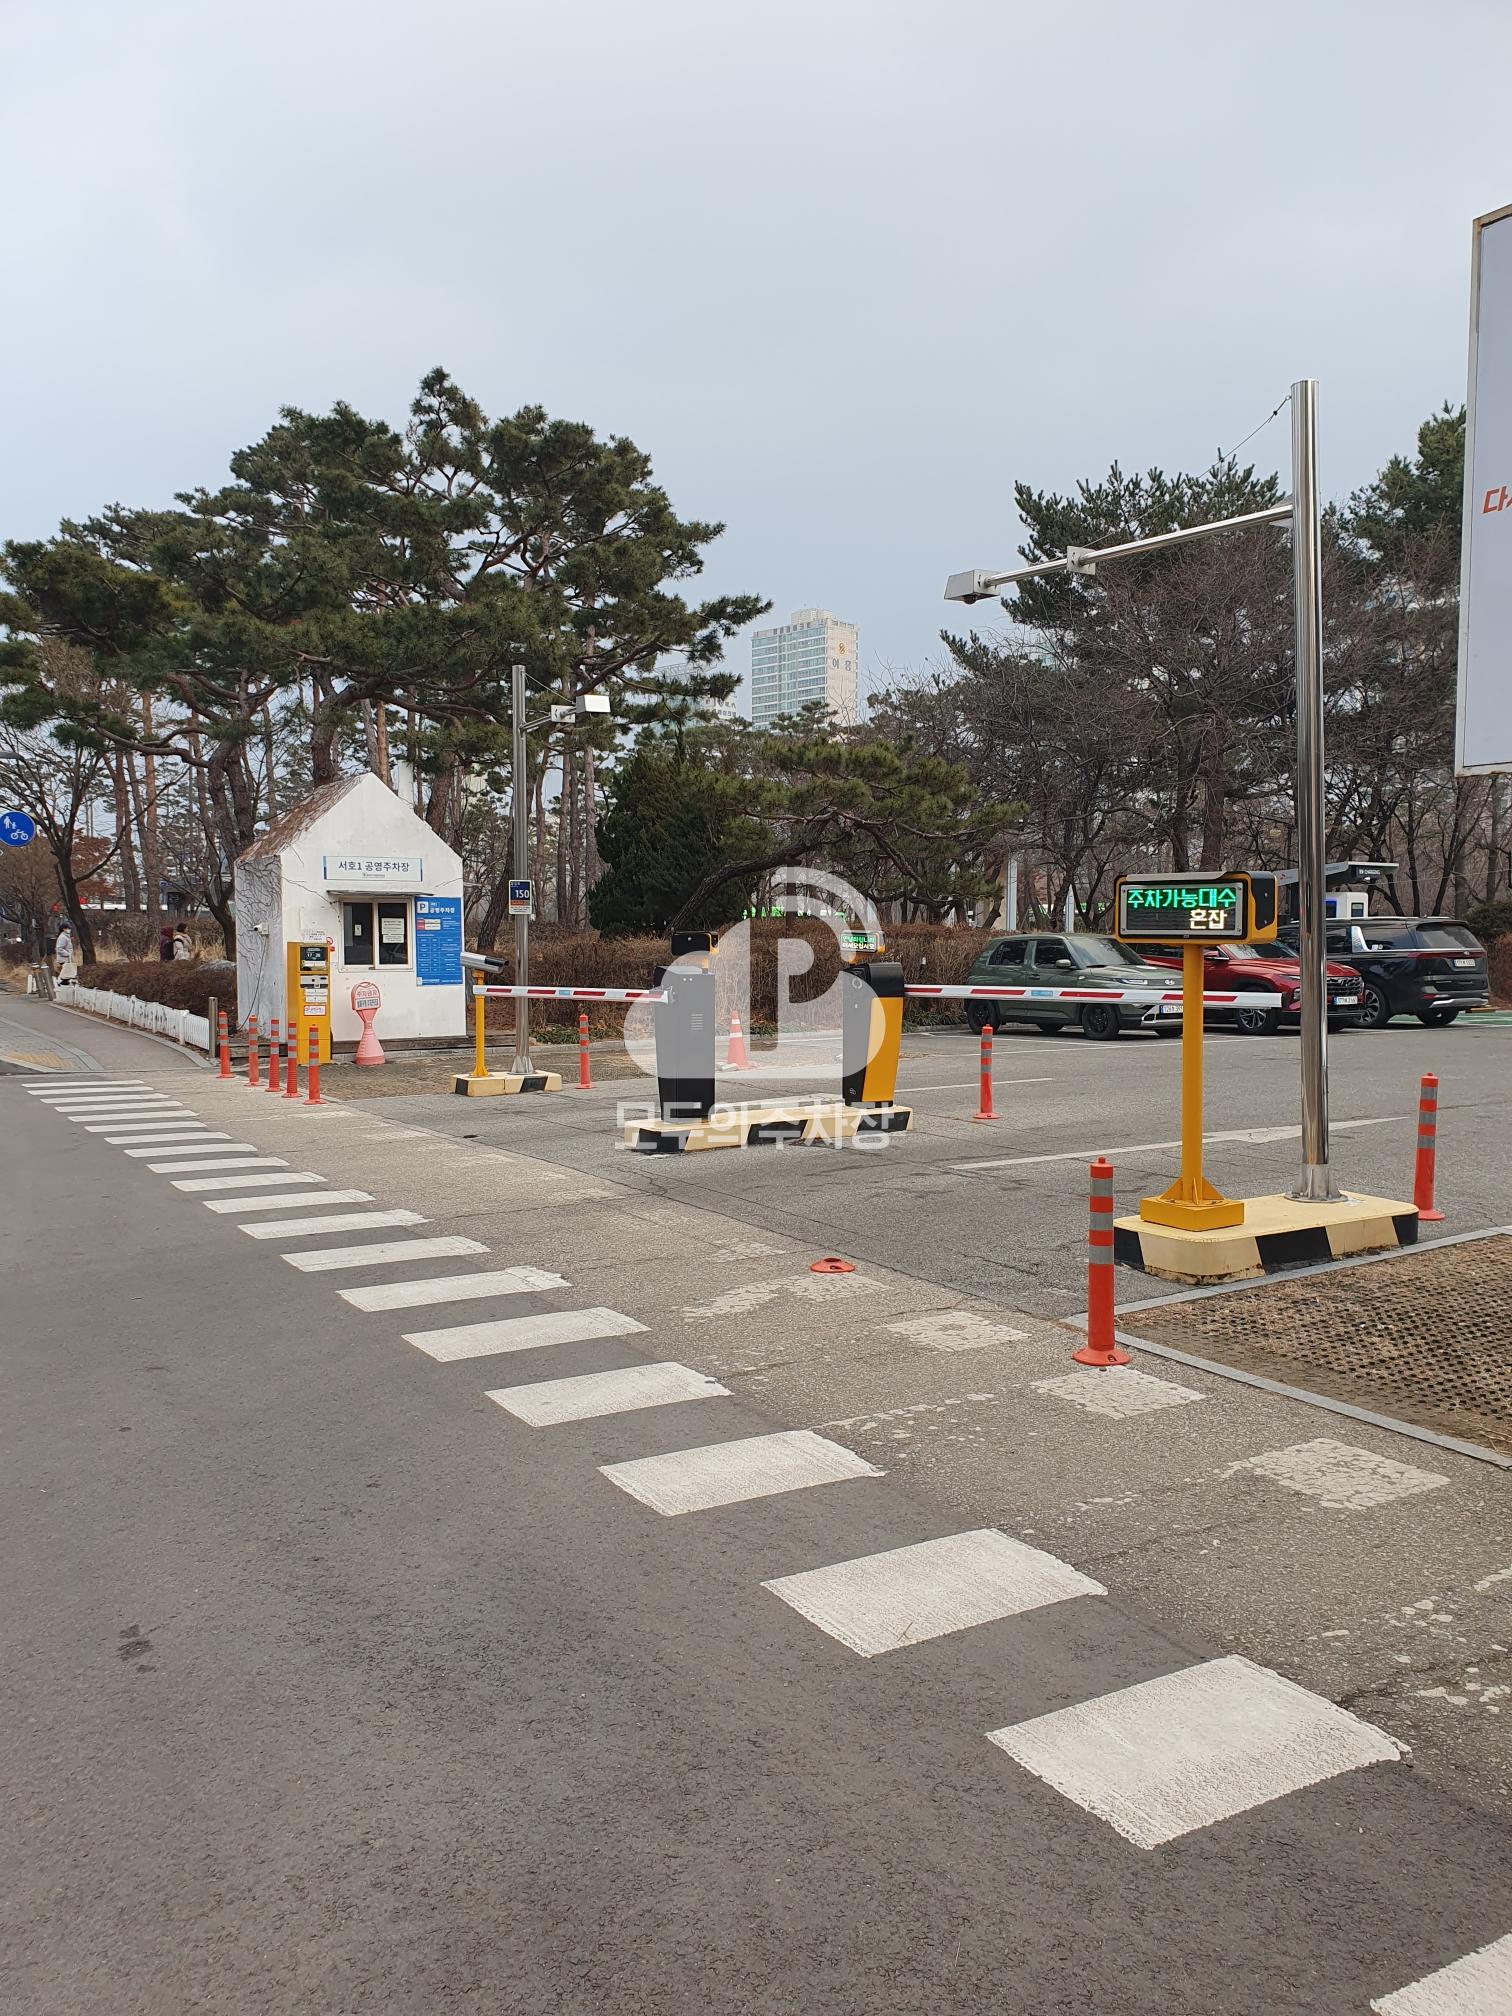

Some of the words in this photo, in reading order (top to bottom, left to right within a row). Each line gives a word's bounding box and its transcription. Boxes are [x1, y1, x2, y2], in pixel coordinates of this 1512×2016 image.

[338, 861, 362, 871] 서호1
[365, 861, 409, 872] 공영주차장
[515, 889, 529, 898] 150
[1127, 888, 1236, 908] 주차가능대수
[1189, 908, 1228, 929] 혼잡
